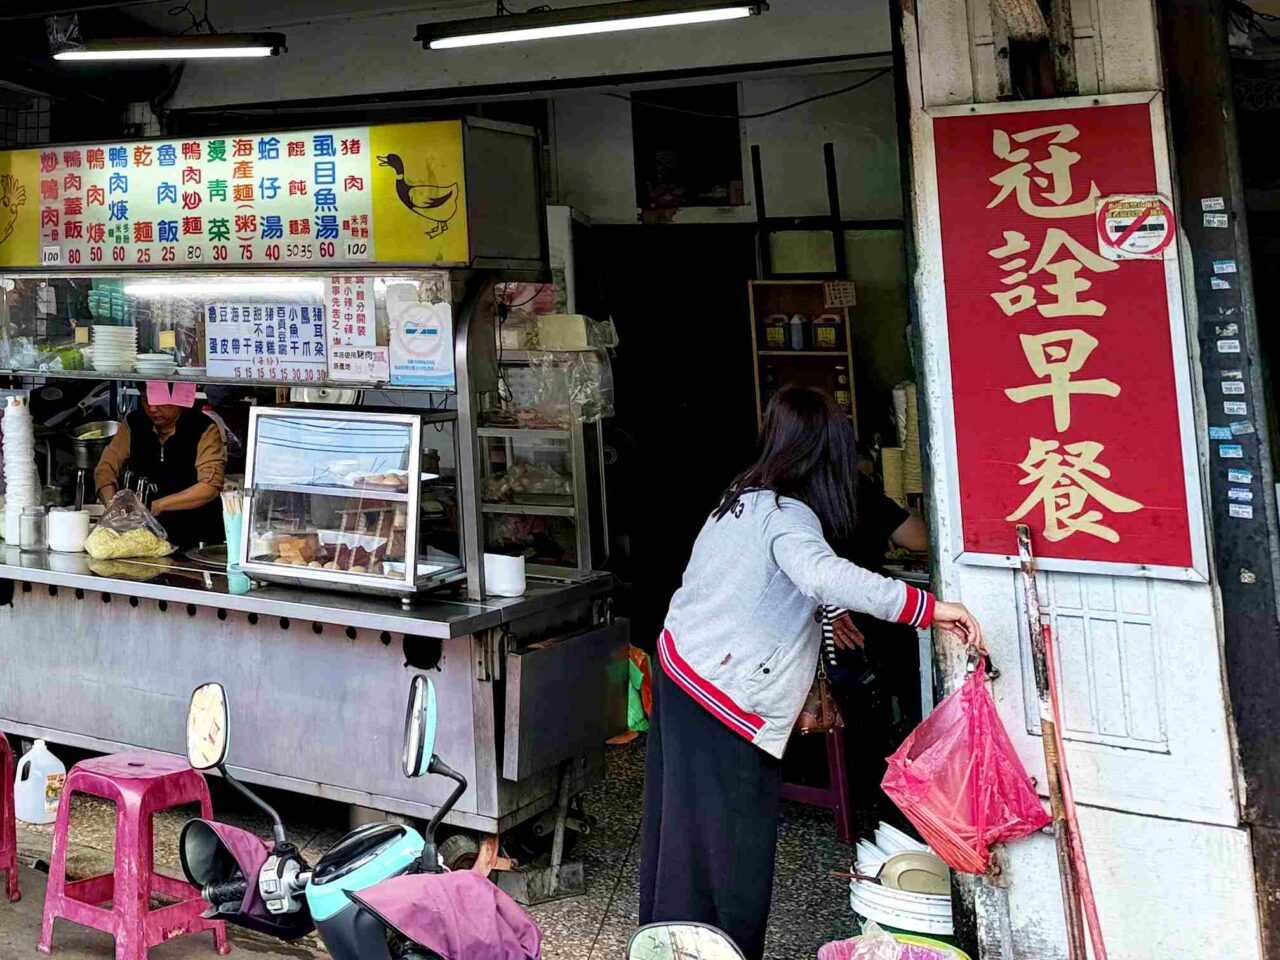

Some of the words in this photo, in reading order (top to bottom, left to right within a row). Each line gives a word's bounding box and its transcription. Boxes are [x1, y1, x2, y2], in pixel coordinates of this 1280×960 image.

[63, 150, 83, 239] 鴨肉蓋飯
[133, 144, 154, 243] 乾麵
[157, 143, 179, 243] 魯肉飯
[181, 141, 203, 235] 鴨肉炒麵
[258, 136, 283, 240] 蛤仔湯
[313, 134, 339, 240] 虱目魚湯
[43, 251, 59, 262] 100
[69, 249, 81, 264] 80
[90, 246, 102, 261] 50
[113, 246, 125, 261] 60
[137, 249, 151, 263] 25
[162, 246, 175, 261] 25
[187, 246, 202, 259] 80
[213, 245, 227, 260] 30
[239, 245, 253, 260] 75
[265, 245, 280, 260] 40
[320, 242, 335, 258] 60
[347, 244, 366, 255] 100
[985, 123, 1144, 544] 冠詮早餐
